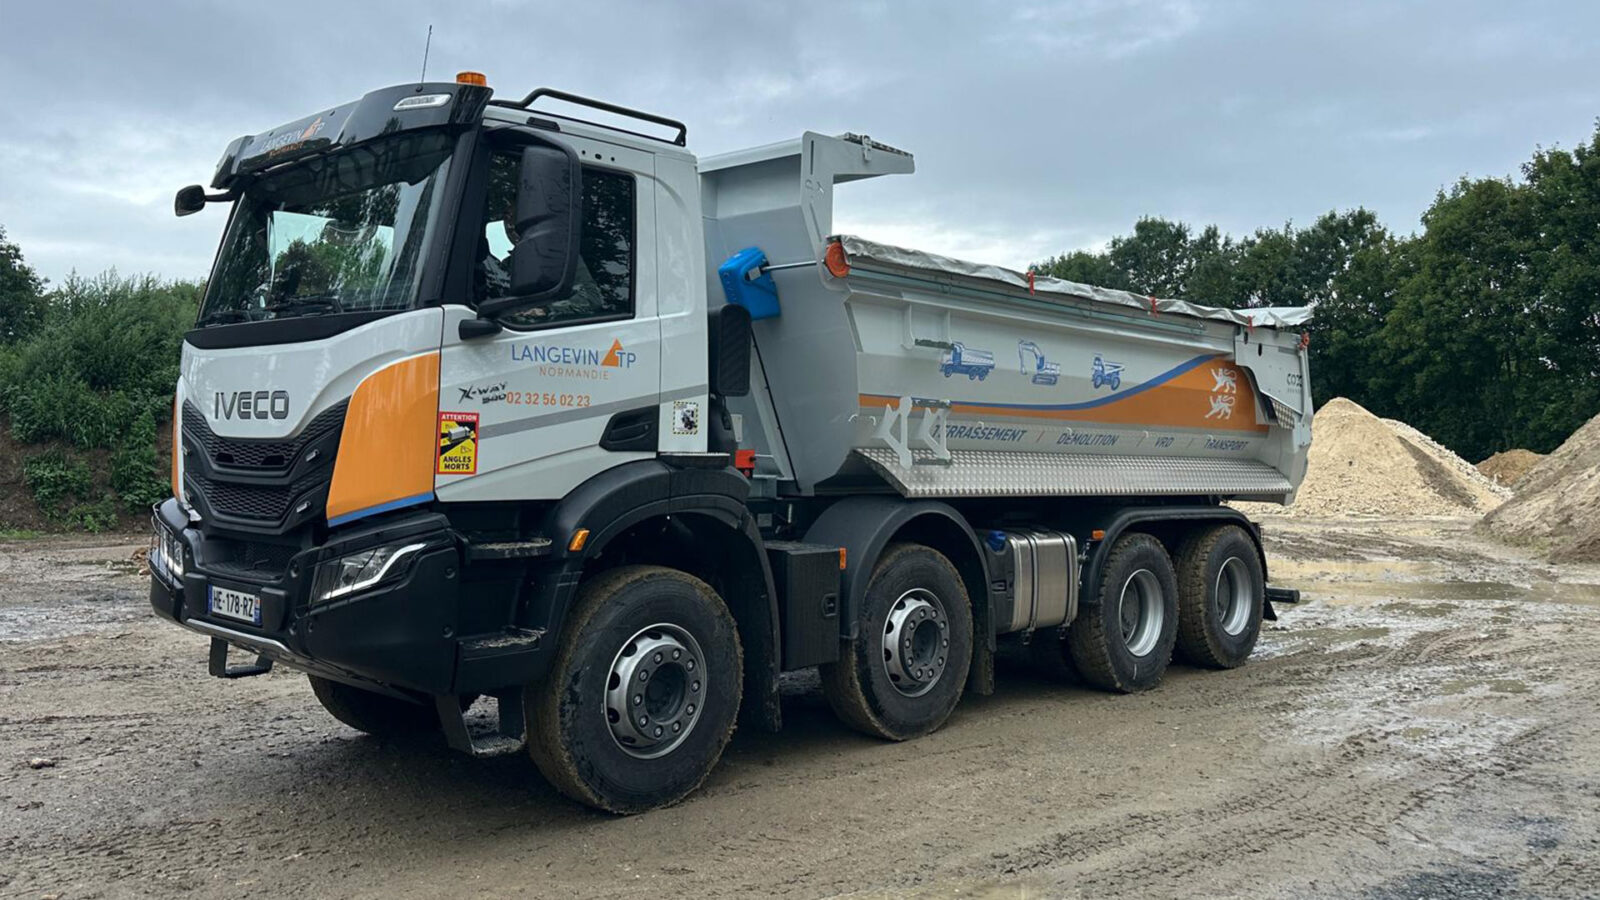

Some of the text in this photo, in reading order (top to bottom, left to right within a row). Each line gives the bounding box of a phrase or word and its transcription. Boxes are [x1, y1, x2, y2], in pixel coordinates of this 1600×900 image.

[511, 344, 637, 368] LANGEVIN TP
[539, 366, 609, 380] NORMANDIE
[215, 390, 289, 420] IVECO
[506, 391, 591, 408] 02 32 56 02 23
[441, 413, 477, 421] ATTENTION
[931, 424, 1027, 441] TRRASSEMENT
[213, 589, 254, 618] HE-178-RZ
